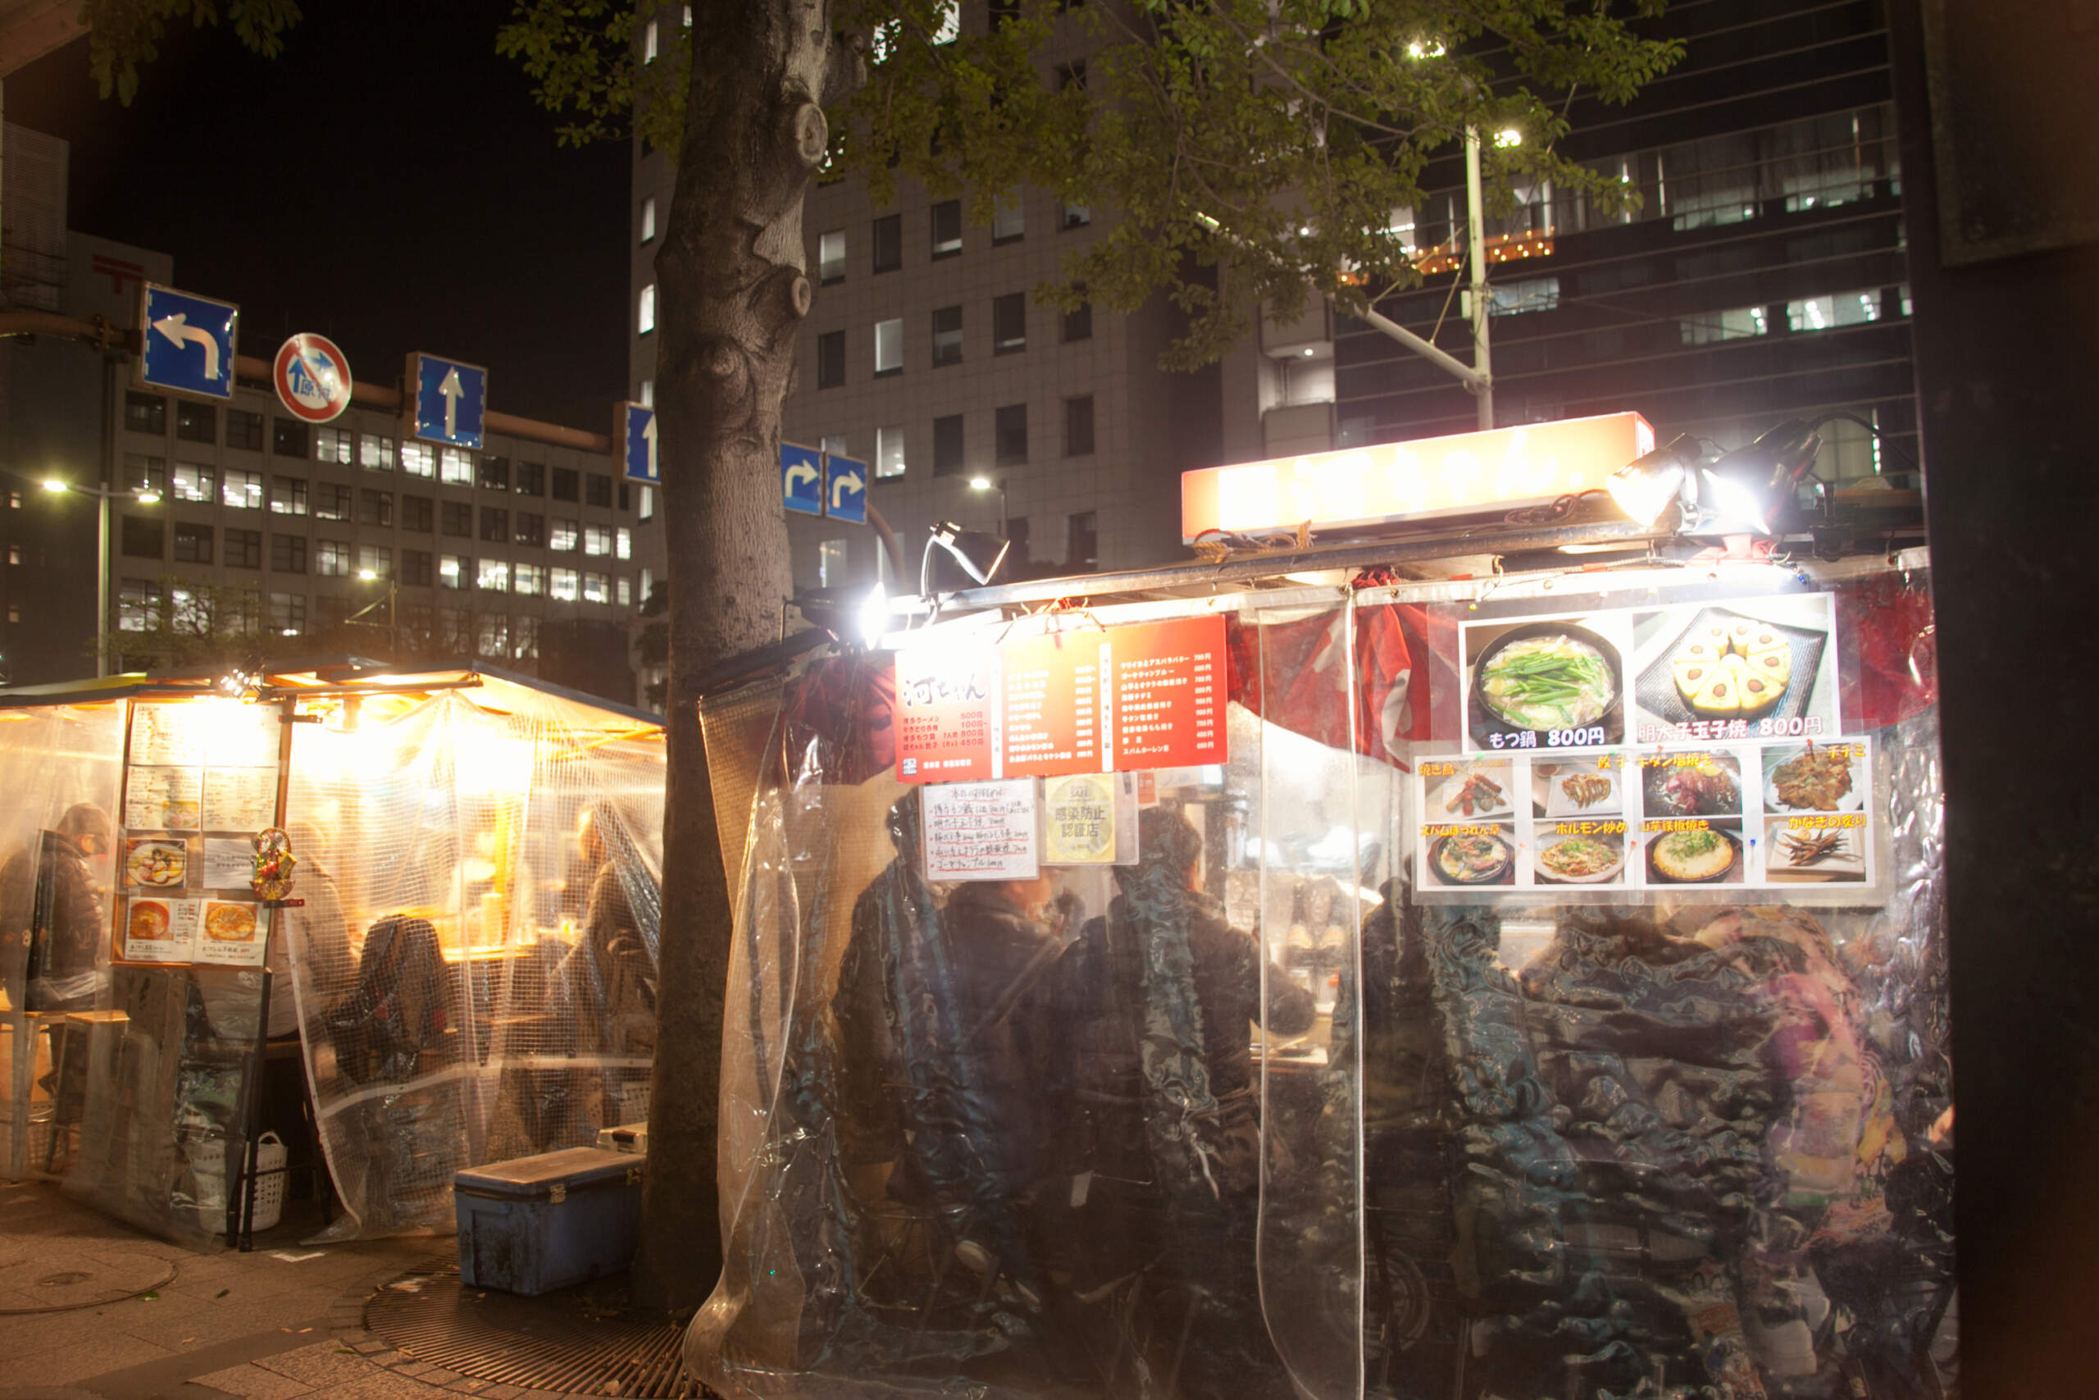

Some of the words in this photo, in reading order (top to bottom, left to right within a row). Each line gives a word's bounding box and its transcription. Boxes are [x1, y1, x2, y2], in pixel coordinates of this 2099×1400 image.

[1489, 729, 1537, 750] もつ鍋
[1547, 726, 1605, 747] 800円
[1638, 719, 1747, 744] 明太子玉子焼
[1758, 716, 1823, 737] 800円
[1418, 762, 1456, 777] 焼き鳥
[1055, 805, 1106, 822] 感染防止
[1061, 823, 1100, 838] 認証店
[1555, 821, 1629, 835] ホルモン炒め
